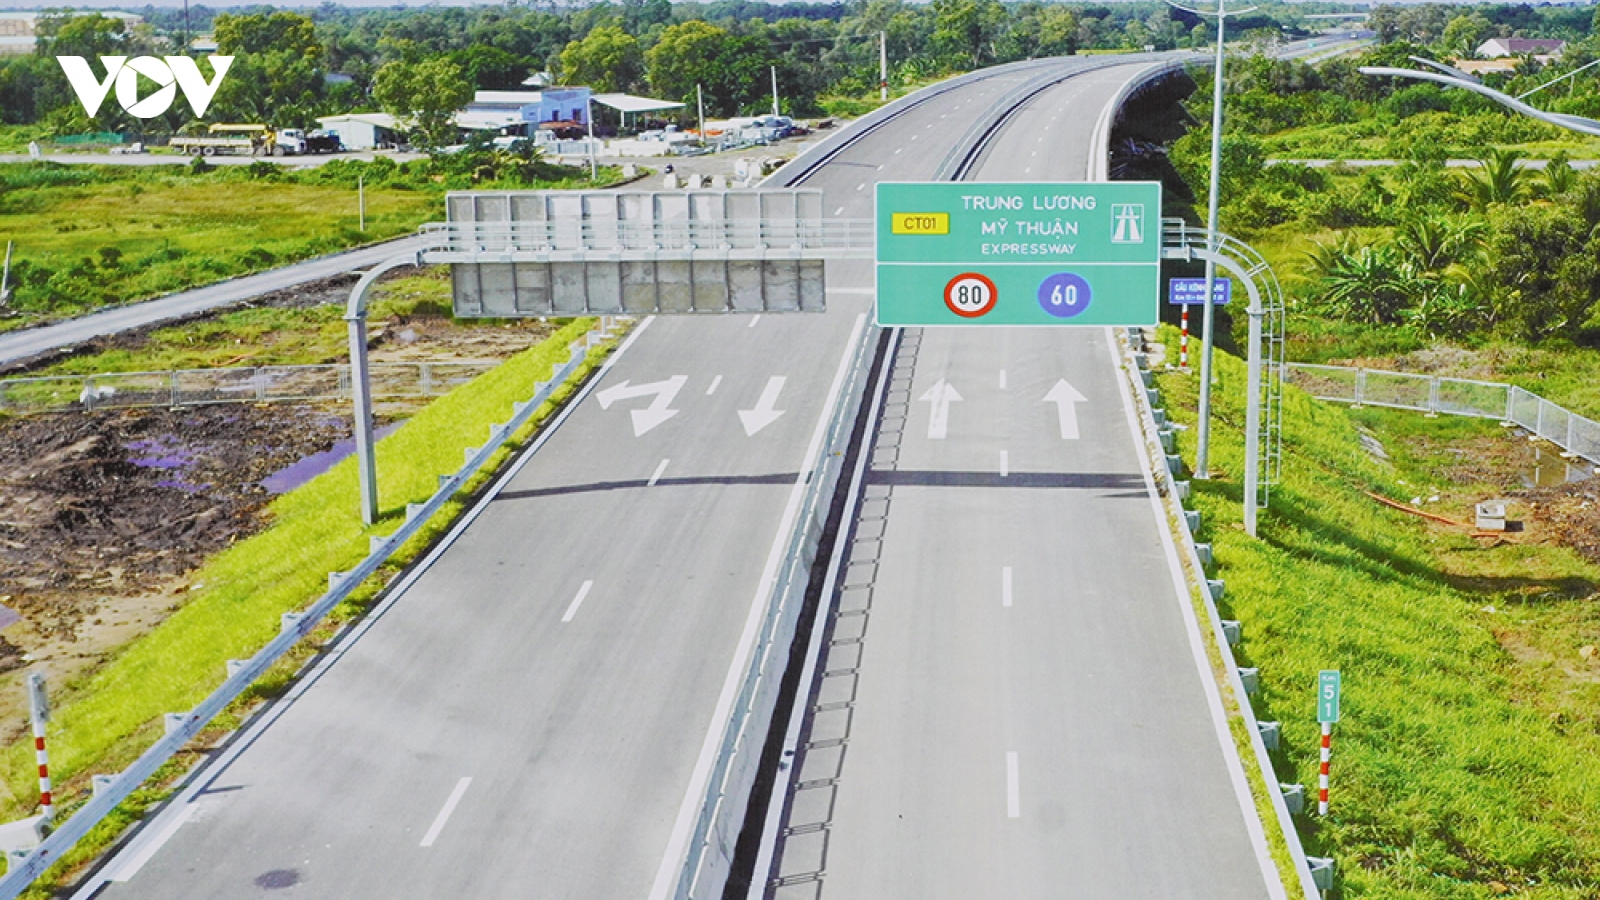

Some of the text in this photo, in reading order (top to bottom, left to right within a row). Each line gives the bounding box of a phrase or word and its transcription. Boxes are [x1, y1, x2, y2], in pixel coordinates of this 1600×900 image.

[961, 194, 1097, 210] TRUNG LƯƠNG
[903, 217, 937, 230] CT01
[981, 217, 1078, 240] MỸ THUẬN
[981, 243, 1077, 255] EXPRESSWAY
[958, 285, 982, 305] 80
[1051, 284, 1078, 305] 60
